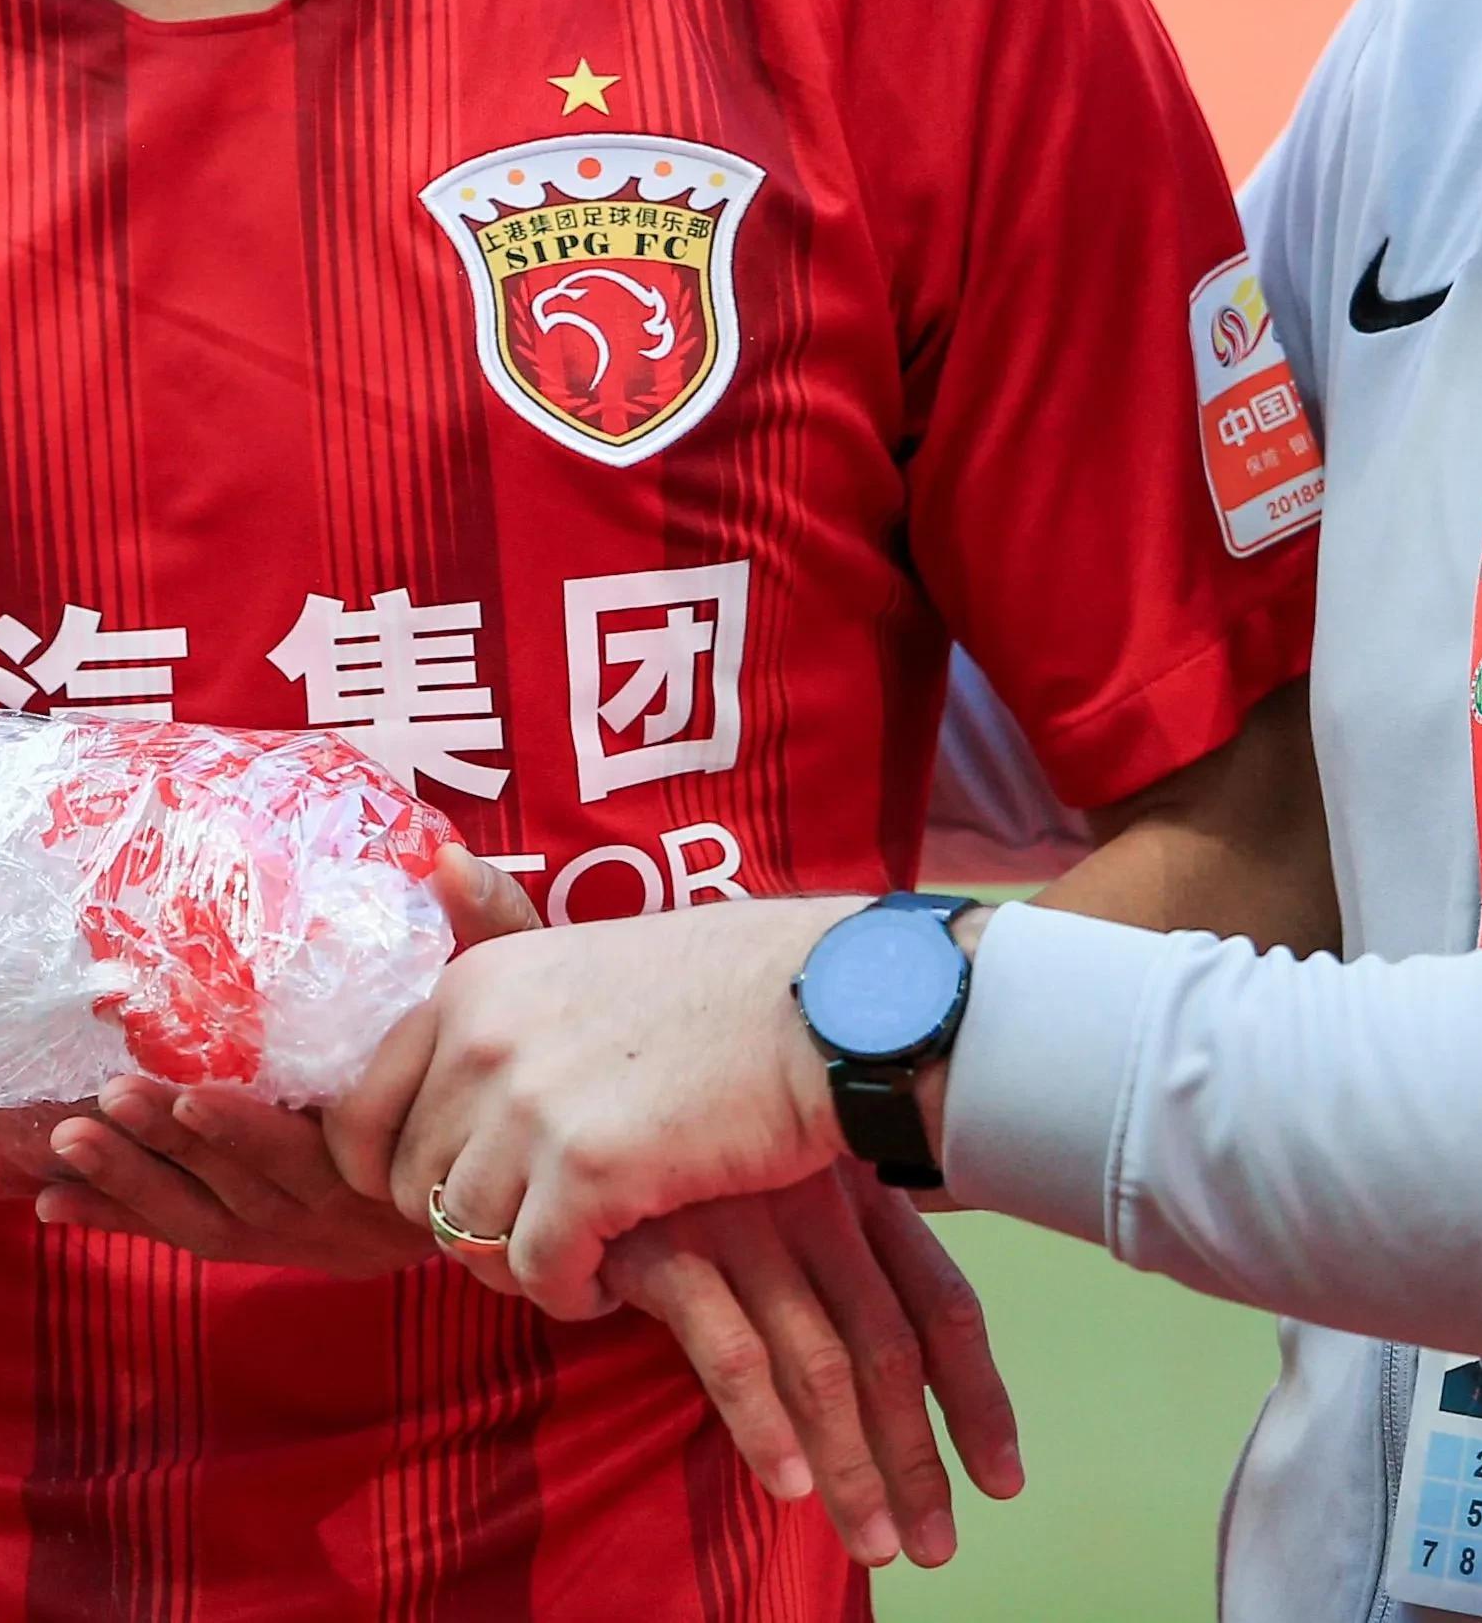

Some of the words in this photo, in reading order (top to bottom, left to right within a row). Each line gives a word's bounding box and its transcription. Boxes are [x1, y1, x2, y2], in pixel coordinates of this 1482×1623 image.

[483, 206, 712, 254] 上港集团足球俱乐部
[505, 232, 610, 270] SIPG
[633, 232, 689, 261] FC
[1422, 1540, 1438, 1567] 7
[1459, 1547, 1476, 1575] 8
